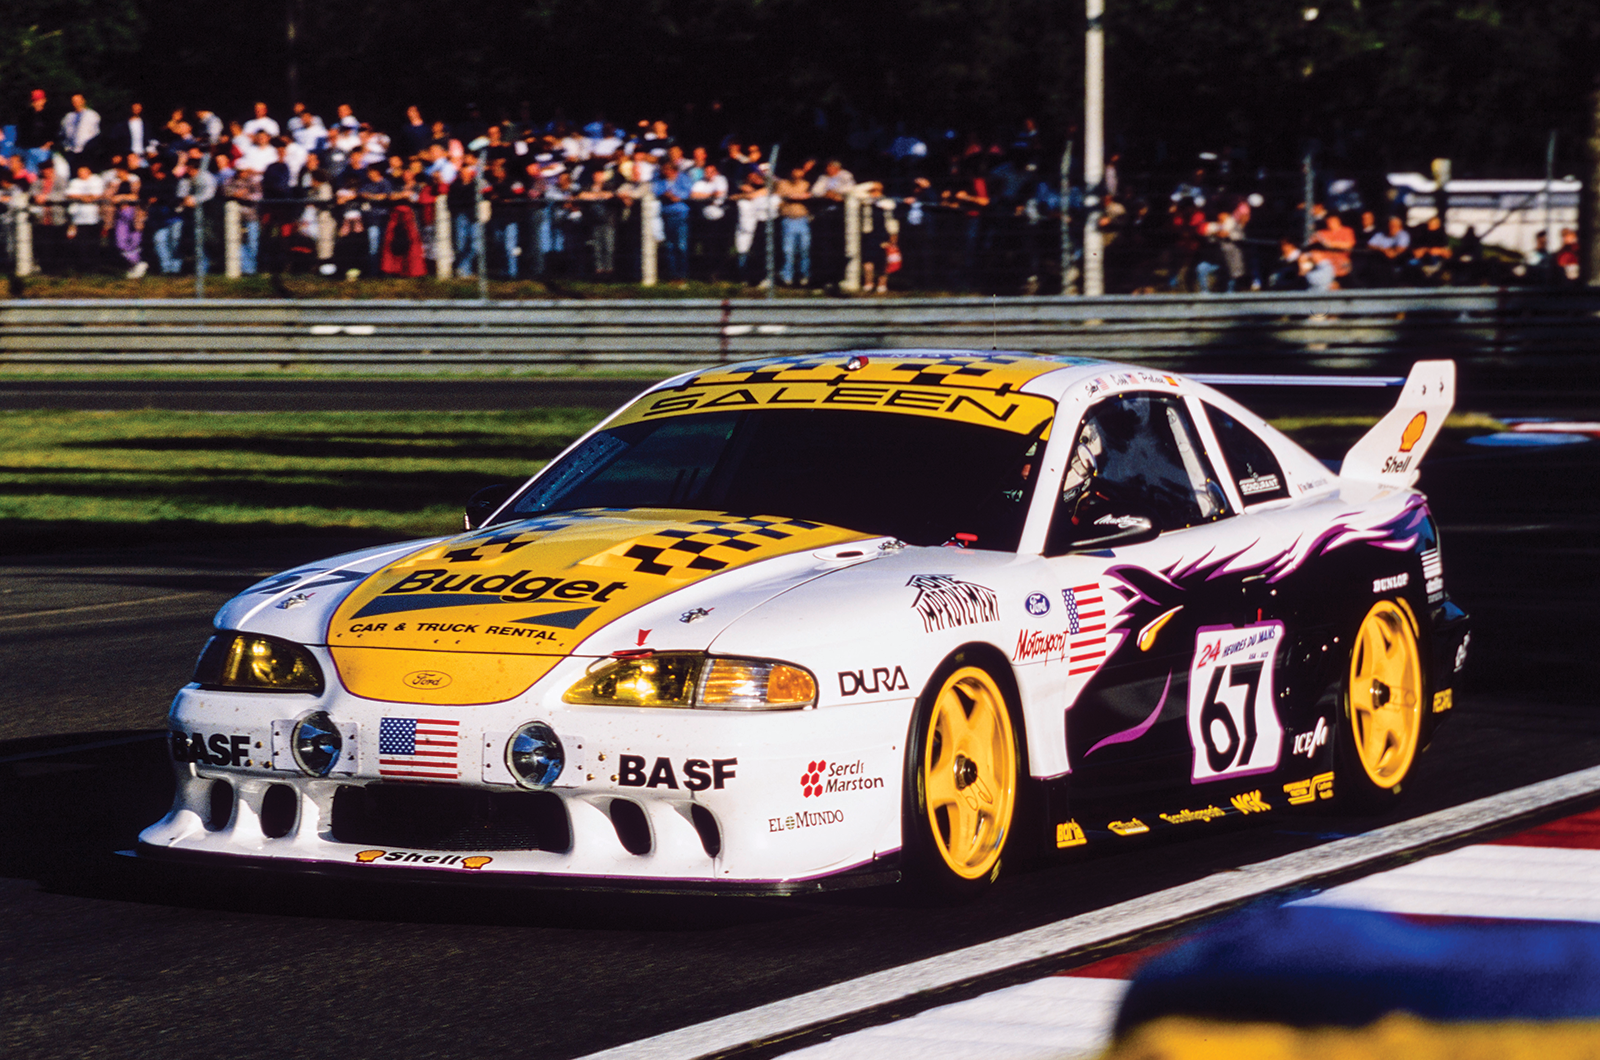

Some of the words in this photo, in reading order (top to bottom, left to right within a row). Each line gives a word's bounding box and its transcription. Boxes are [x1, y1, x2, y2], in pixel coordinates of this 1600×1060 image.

[643, 386, 1020, 422] SALEEN
[1381, 455, 1412, 473] Shell
[381, 569, 628, 603] Budget
[1373, 572, 1409, 593] DUNLOP
[1028, 594, 1048, 613] Ford
[349, 622, 388, 633] CAR
[394, 622, 407, 631] &
[416, 622, 480, 633] TRUCK
[484, 625, 559, 641] RENTAL
[1012, 628, 1070, 666] Motorsport
[1196, 637, 1222, 670] 24
[411, 672, 443, 687] Ford
[837, 665, 910, 697] DURA
[1200, 660, 1265, 773] 67
[171, 731, 250, 767] BASF
[618, 754, 738, 791] BASF
[825, 777, 884, 793] Marston
[1230, 789, 1271, 815] NGK
[768, 818, 785, 832] EL
[795, 809, 844, 829] MUNDO
[383, 852, 461, 866] Shell
